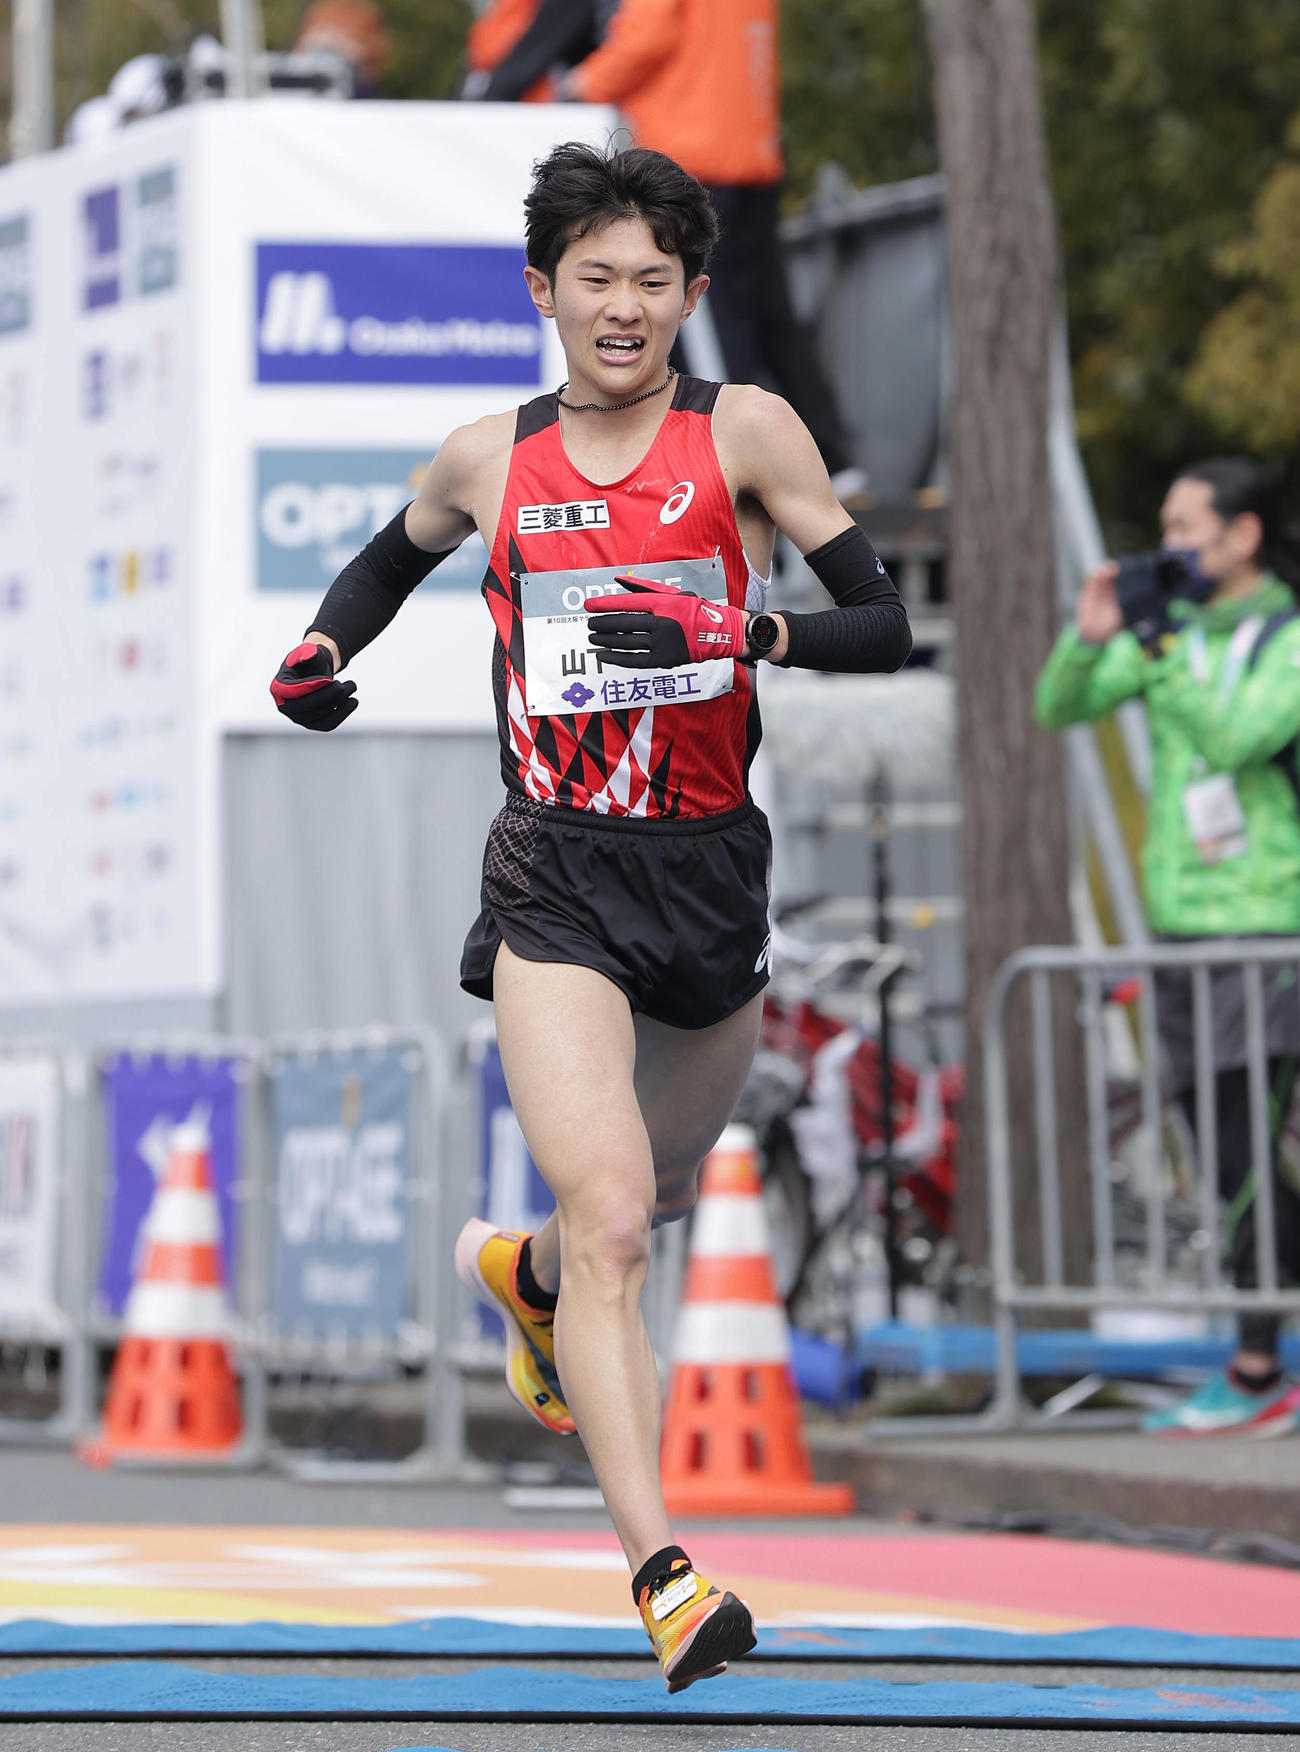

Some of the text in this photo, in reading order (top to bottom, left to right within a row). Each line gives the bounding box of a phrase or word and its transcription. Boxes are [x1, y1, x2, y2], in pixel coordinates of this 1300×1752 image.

[262, 482, 412, 548] OPT
[520, 504, 608, 530] 三菱重工
[697, 631, 732, 644] 三菱重工
[600, 672, 701, 705] 住友電工
